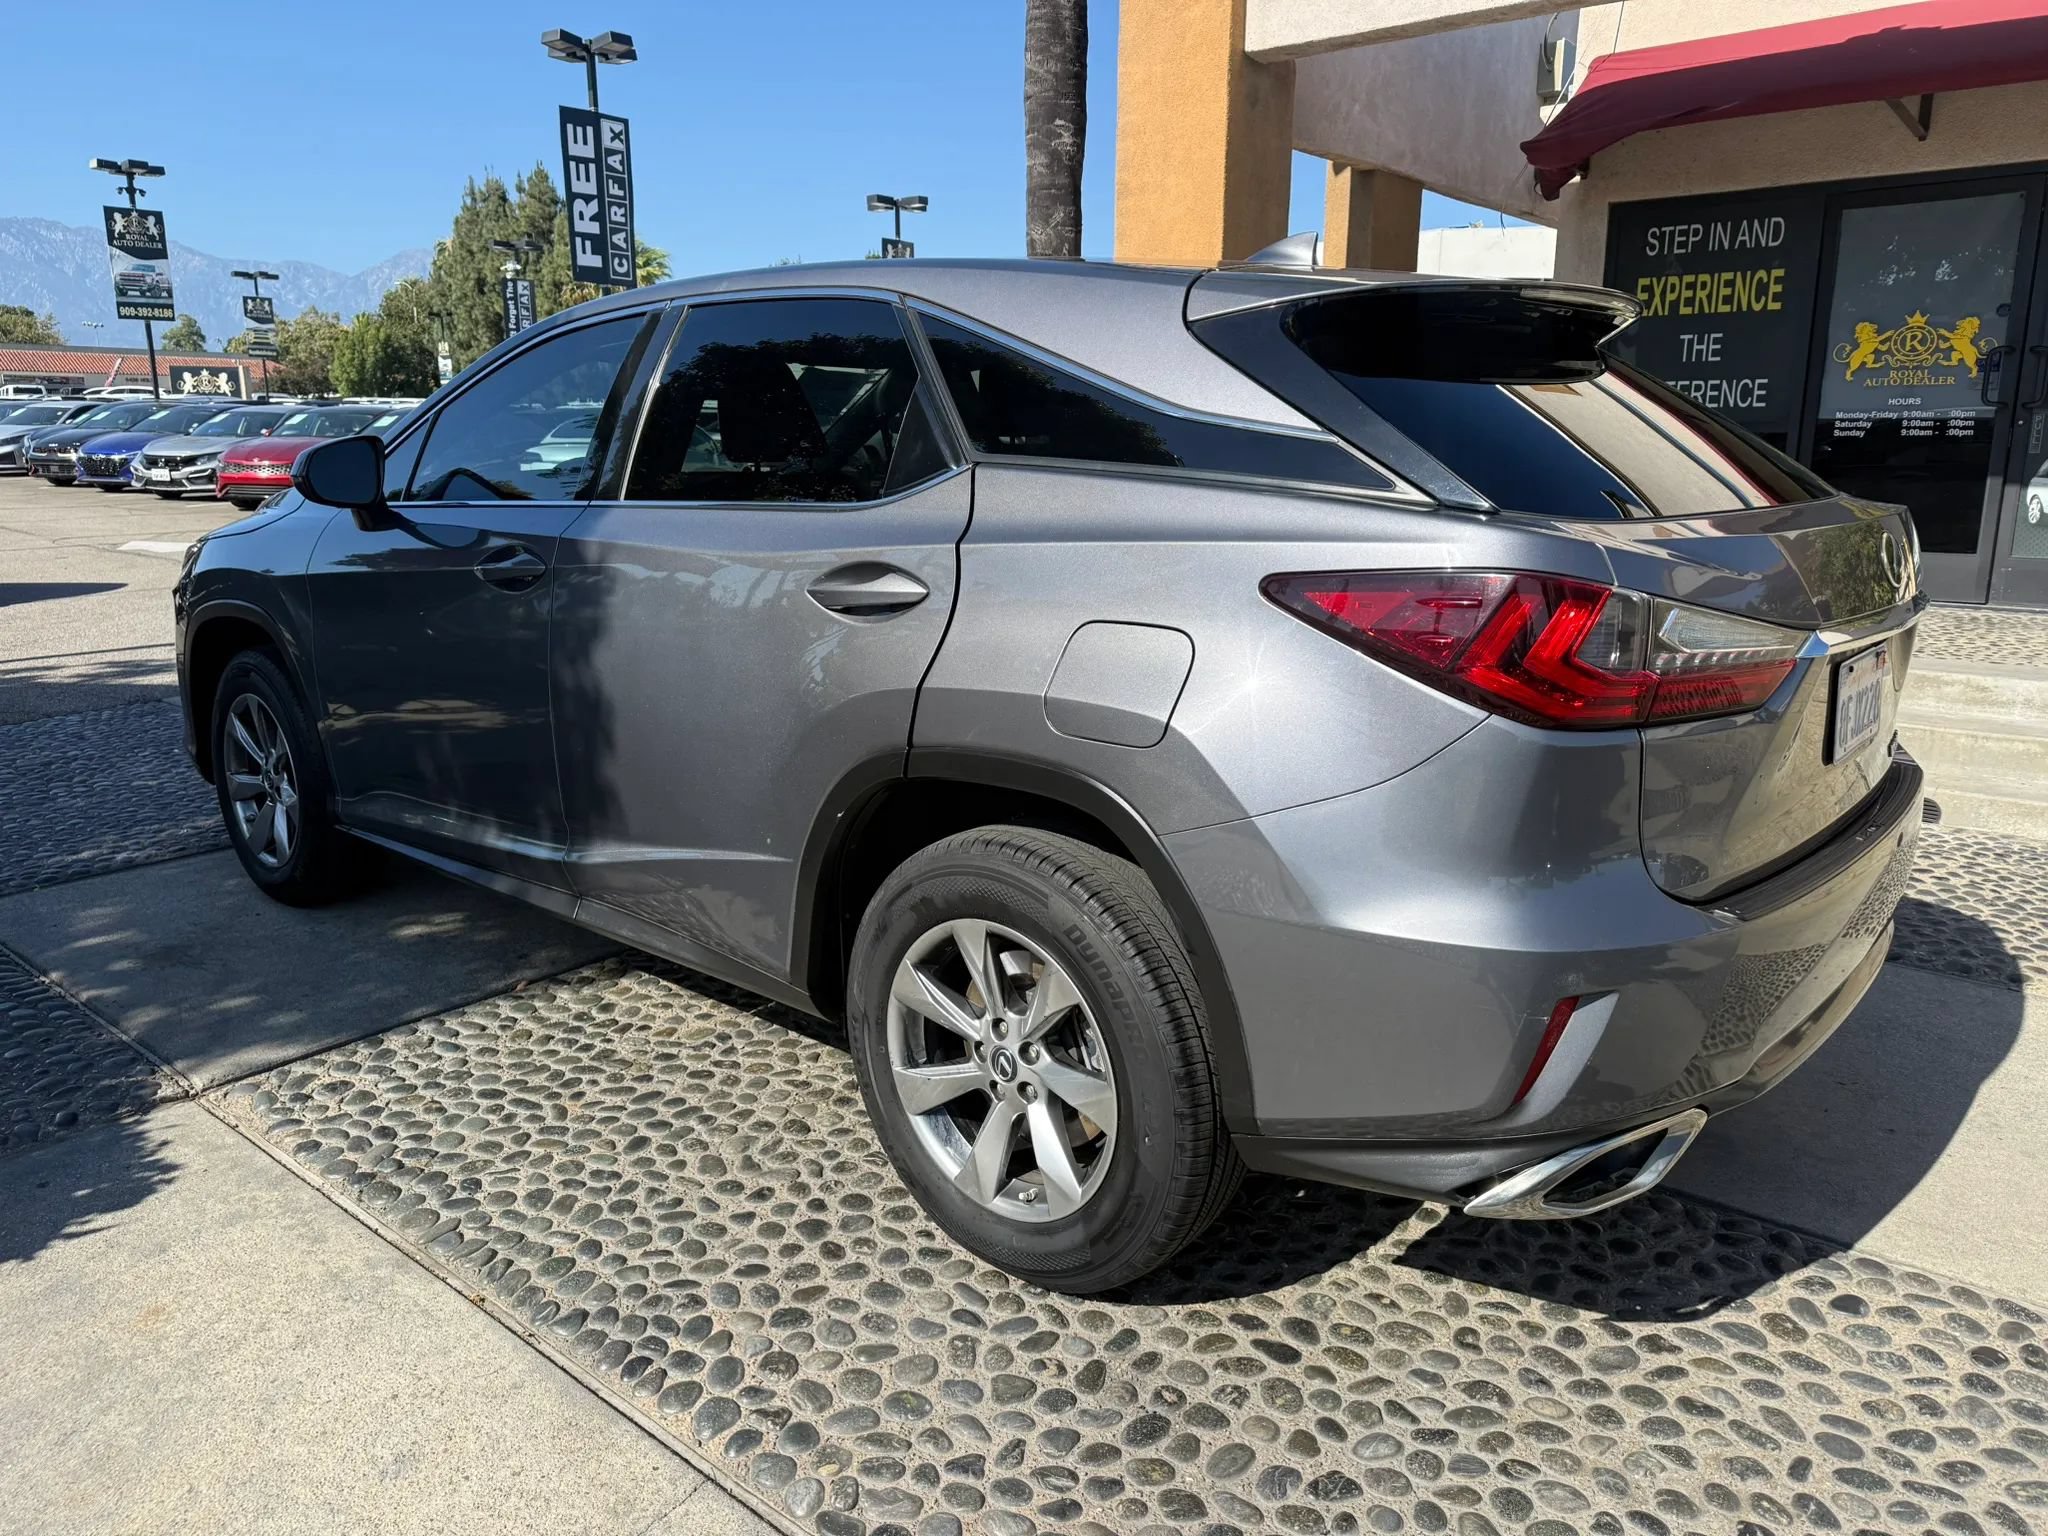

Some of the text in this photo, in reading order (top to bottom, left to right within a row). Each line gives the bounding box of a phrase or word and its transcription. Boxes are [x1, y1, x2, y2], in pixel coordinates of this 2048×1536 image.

[566, 123, 603, 268] FREE
[606, 125, 629, 274] CARFAX
[125, 233, 149, 241] ROYAL
[135, 241, 163, 249] DEALER
[1645, 217, 1785, 256] STEP IN AND
[506, 281, 514, 299] The
[1636, 268, 1785, 317] EXPERIENCE
[507, 300, 517, 329] Forget
[520, 283, 531, 328] RFAX
[1679, 333, 1723, 363] THE
[1905, 331, 1925, 352] R
[1863, 376, 1956, 387] AUTO DEALER
[1889, 369, 1932, 379] ROYAL
[1664, 378, 1769, 409] ERENCE
[1888, 397, 1922, 406] HOURS
[1834, 420, 1873, 429] Saturday
[1835, 411, 1899, 420] Monday-Friday
[1902, 410, 1935, 418] 9:00am
[1833, 429, 1866, 438] Sunday
[2032, 415, 2042, 444] PULL
